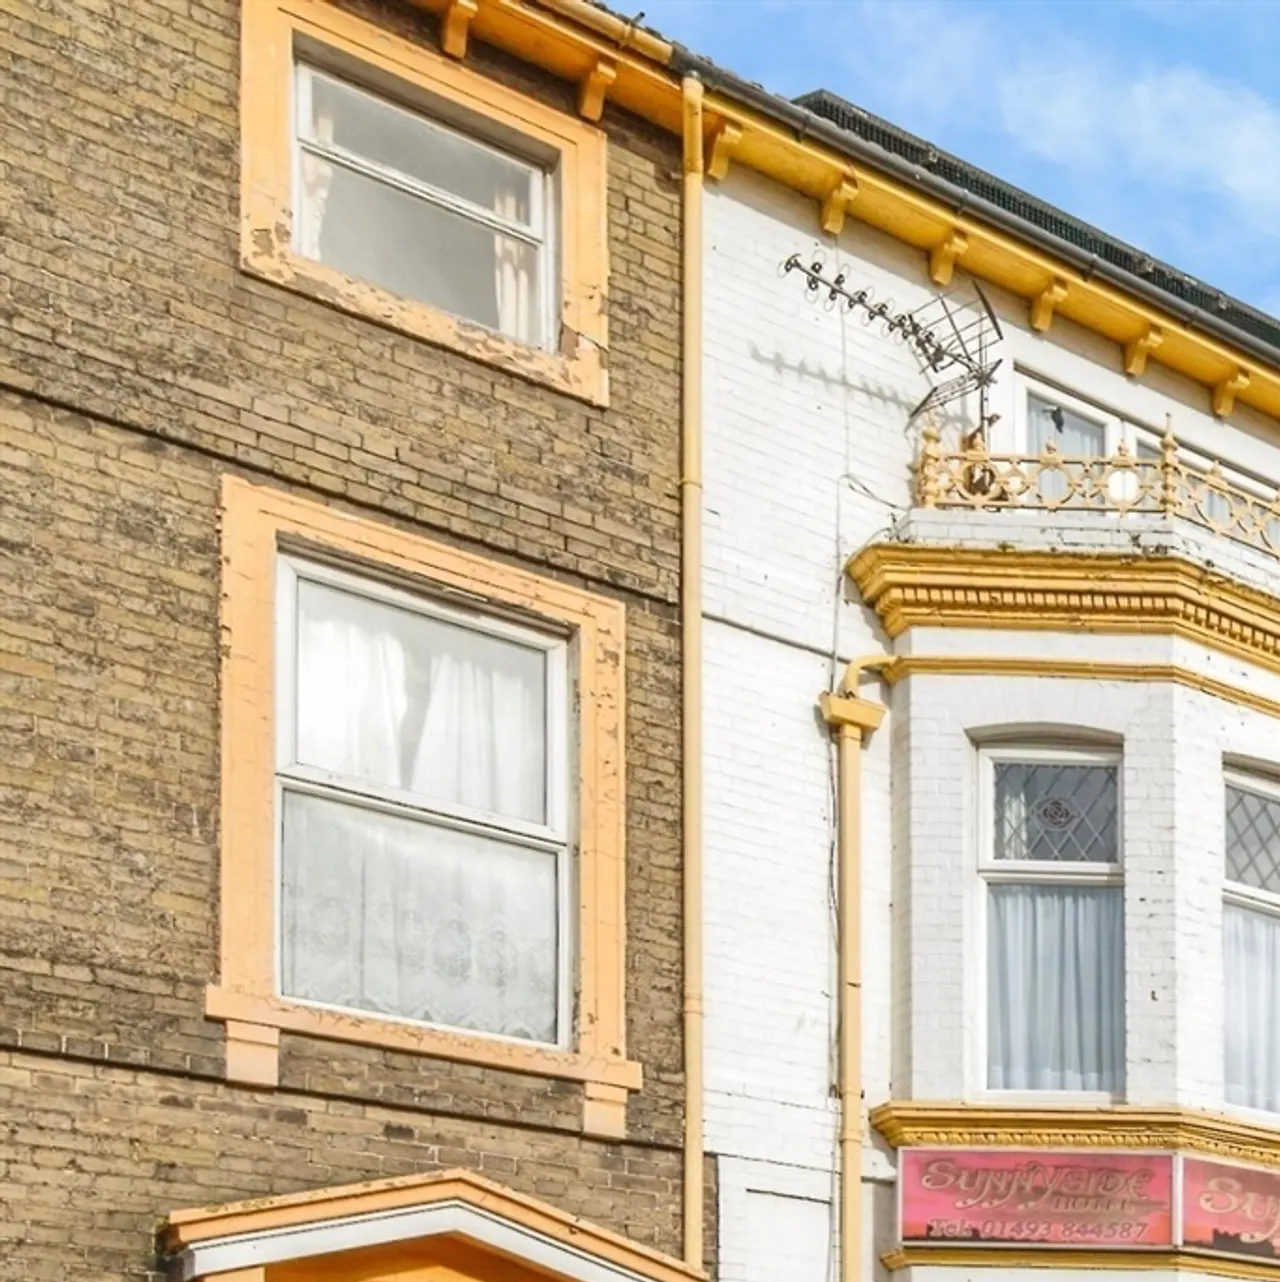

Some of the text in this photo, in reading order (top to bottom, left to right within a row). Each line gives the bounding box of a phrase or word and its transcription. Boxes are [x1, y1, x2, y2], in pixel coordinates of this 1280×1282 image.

[1052, 1197, 1135, 1213] HOTEL
[981, 1219, 1052, 1238] 01493
[1062, 1221, 1148, 1240] 844587
